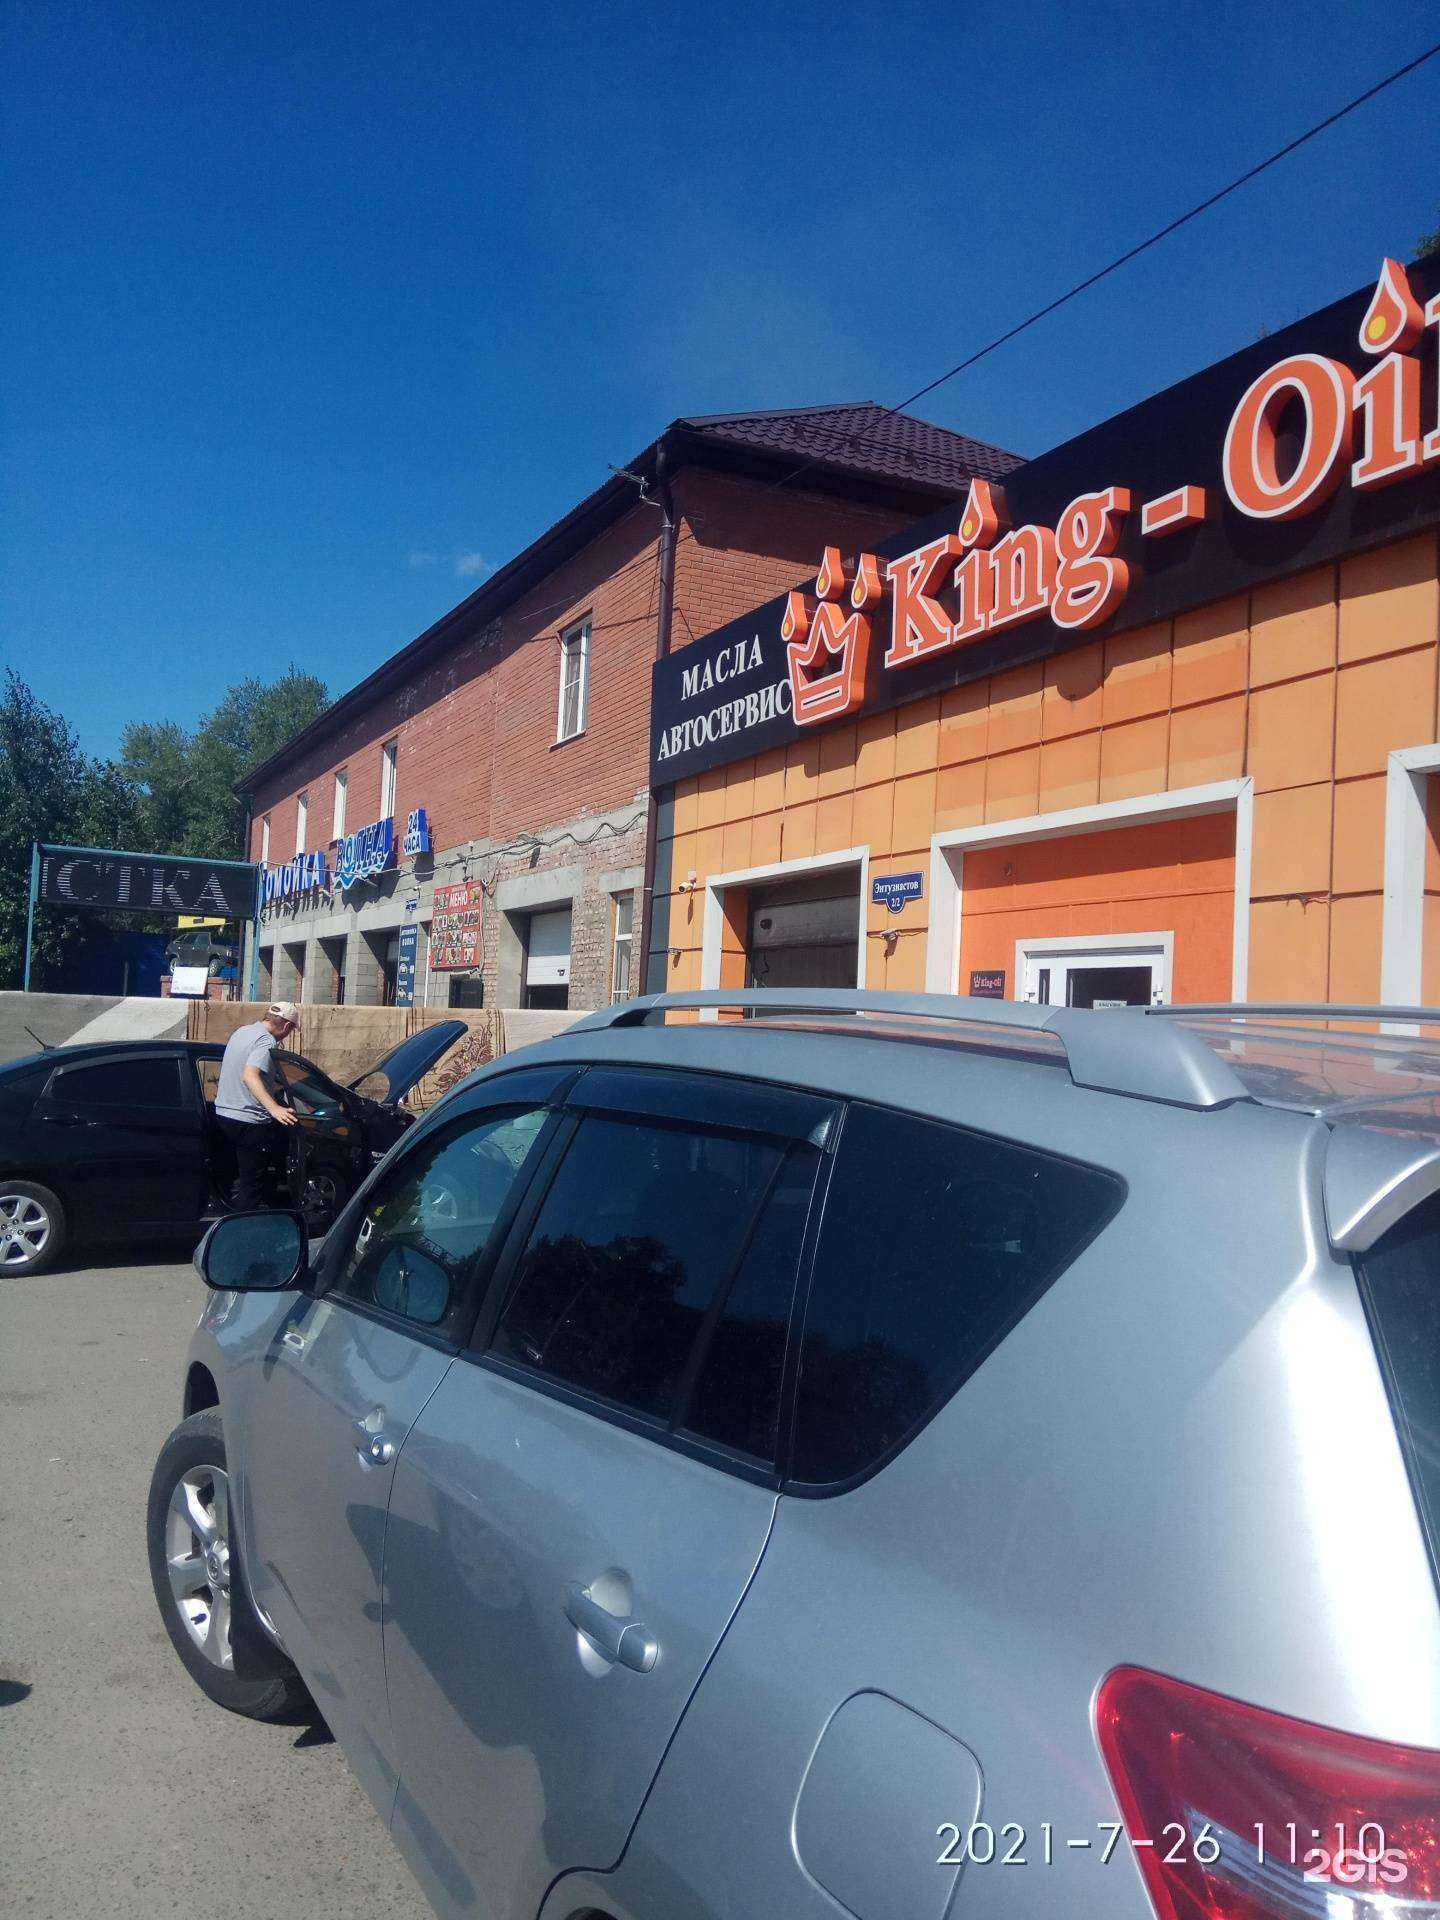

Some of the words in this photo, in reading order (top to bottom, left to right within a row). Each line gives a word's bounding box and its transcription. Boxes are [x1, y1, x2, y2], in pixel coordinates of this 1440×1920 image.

[680, 634, 764, 701] МАСЛА
[656, 678, 793, 762] АВТОСЕРВИС
[408, 812, 419, 834] 24
[262, 850, 320, 902] ОМОЙКА
[449, 891, 468, 908] МЕНЮ
